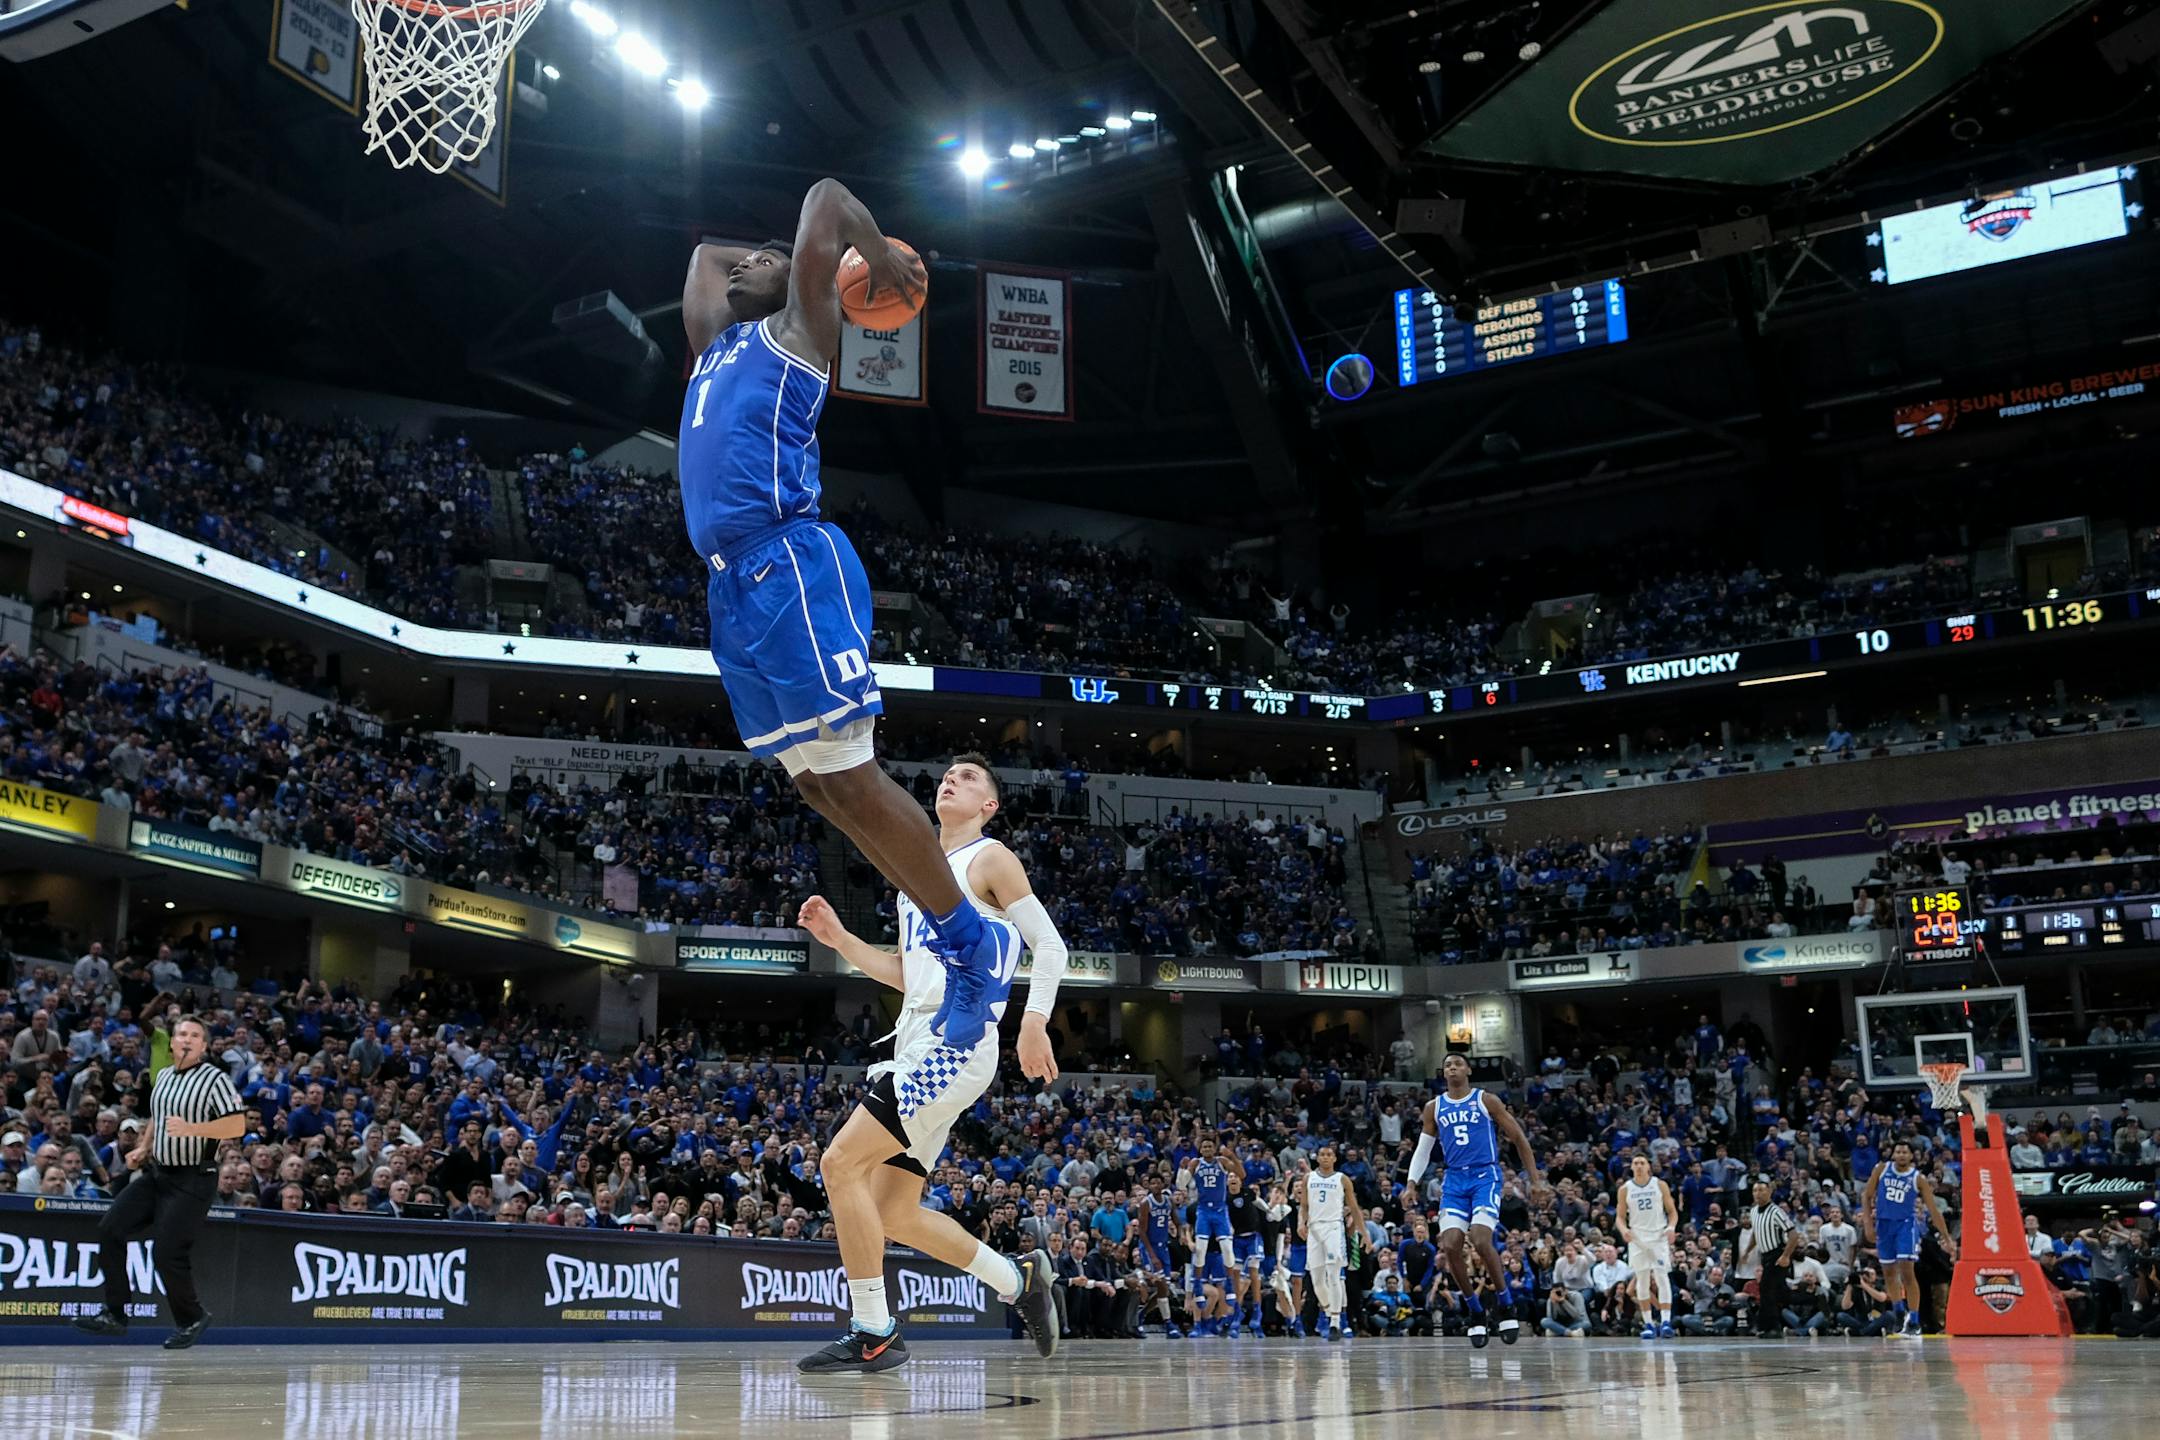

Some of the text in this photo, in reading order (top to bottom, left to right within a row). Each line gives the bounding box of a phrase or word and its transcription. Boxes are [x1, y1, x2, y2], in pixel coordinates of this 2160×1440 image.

[1614, 36, 1887, 116] BANKERS LIFE
[1623, 56, 1895, 135] FIELDHOUSE
[1698, 92, 1827, 130] INDIANAPOLIS
[1001, 285, 1048, 305] WNBA
[998, 309, 1052, 326] EASTERN
[1432, 286, 1583, 331] 7 DEF REBS 9
[990, 323, 1060, 341] CONFERENCE
[1434, 301, 1590, 345] 7 REBOUNDS 12
[992, 337, 1059, 354] CHAMPIONS
[1397, 293, 1413, 382] KENTUCKY
[1434, 315, 1586, 360] 2 ASSISTS 5
[1435, 330, 1586, 374] 0 STEALS 1
[1009, 358, 1042, 376] 2015
[691, 379, 712, 429] 1
[1961, 393, 2005, 413] SUN
[2010, 382, 2065, 403] KING
[1999, 382, 2145, 418] FRESH LOCAL BEER
[2022, 600, 2103, 632] 11:36
[1856, 630, 1890, 654] 10
[1950, 625, 1975, 643] 29
[1626, 652, 1740, 685] KENTUCKY
[1166, 693, 1177, 707] 7
[1209, 696, 1219, 710] 2
[1252, 700, 1287, 715] 4/13
[1432, 699, 1443, 713] 3
[1485, 692, 1496, 705] 6
[1325, 704, 1351, 719] 2/5
[514, 755, 535, 765] Text
[571, 747, 660, 763] NEED HELP?
[1427, 809, 1508, 829] LEXUS
[1965, 798, 2062, 834] planet
[178, 835, 213, 857] SAPPER
[222, 847, 257, 866] MILLER
[292, 862, 382, 898] DEFENDERS
[428, 892, 526, 928] PurdueTeamStore.com
[1911, 891, 1962, 913] 11:36
[1914, 911, 1958, 946] 29
[2005, 917, 2015, 929] 3
[2043, 912, 2082, 929] 11:36
[906, 911, 930, 952] 14
[678, 945, 807, 963] SPORT GRAPHICS
[1795, 941, 1875, 958] Kinetico
[1925, 947, 1971, 960] TISSOT
[1180, 966, 1244, 980] LIGHTBOUND
[1555, 962, 1587, 974] Eaton
[1331, 966, 1389, 992] IUPUI
[1439, 1109, 1481, 1128] DUKE
[1453, 1124, 1470, 1146] 5
[1203, 1175, 1217, 1188] 12
[1309, 1181, 1338, 1190] KENTUCKY
[1883, 1177, 1912, 1193] DUKE
[2058, 1172, 2146, 1195] Cadillac
[1318, 1190, 1326, 1203] 3
[1638, 1198, 1653, 1211] 22
[1885, 1187, 1905, 1204] 20
[1979, 1168, 1997, 1233] StateFarm
[1156, 1215, 1165, 1227] 2
[291, 1241, 467, 1306] SPALDING
[544, 1253, 680, 1309] SPALDING
[741, 1262, 848, 1311] SPALDING
[897, 1268, 987, 1312] SPALDING
[60, 1303, 79, 1317] ARE
[134, 1303, 158, 1317] GAME
